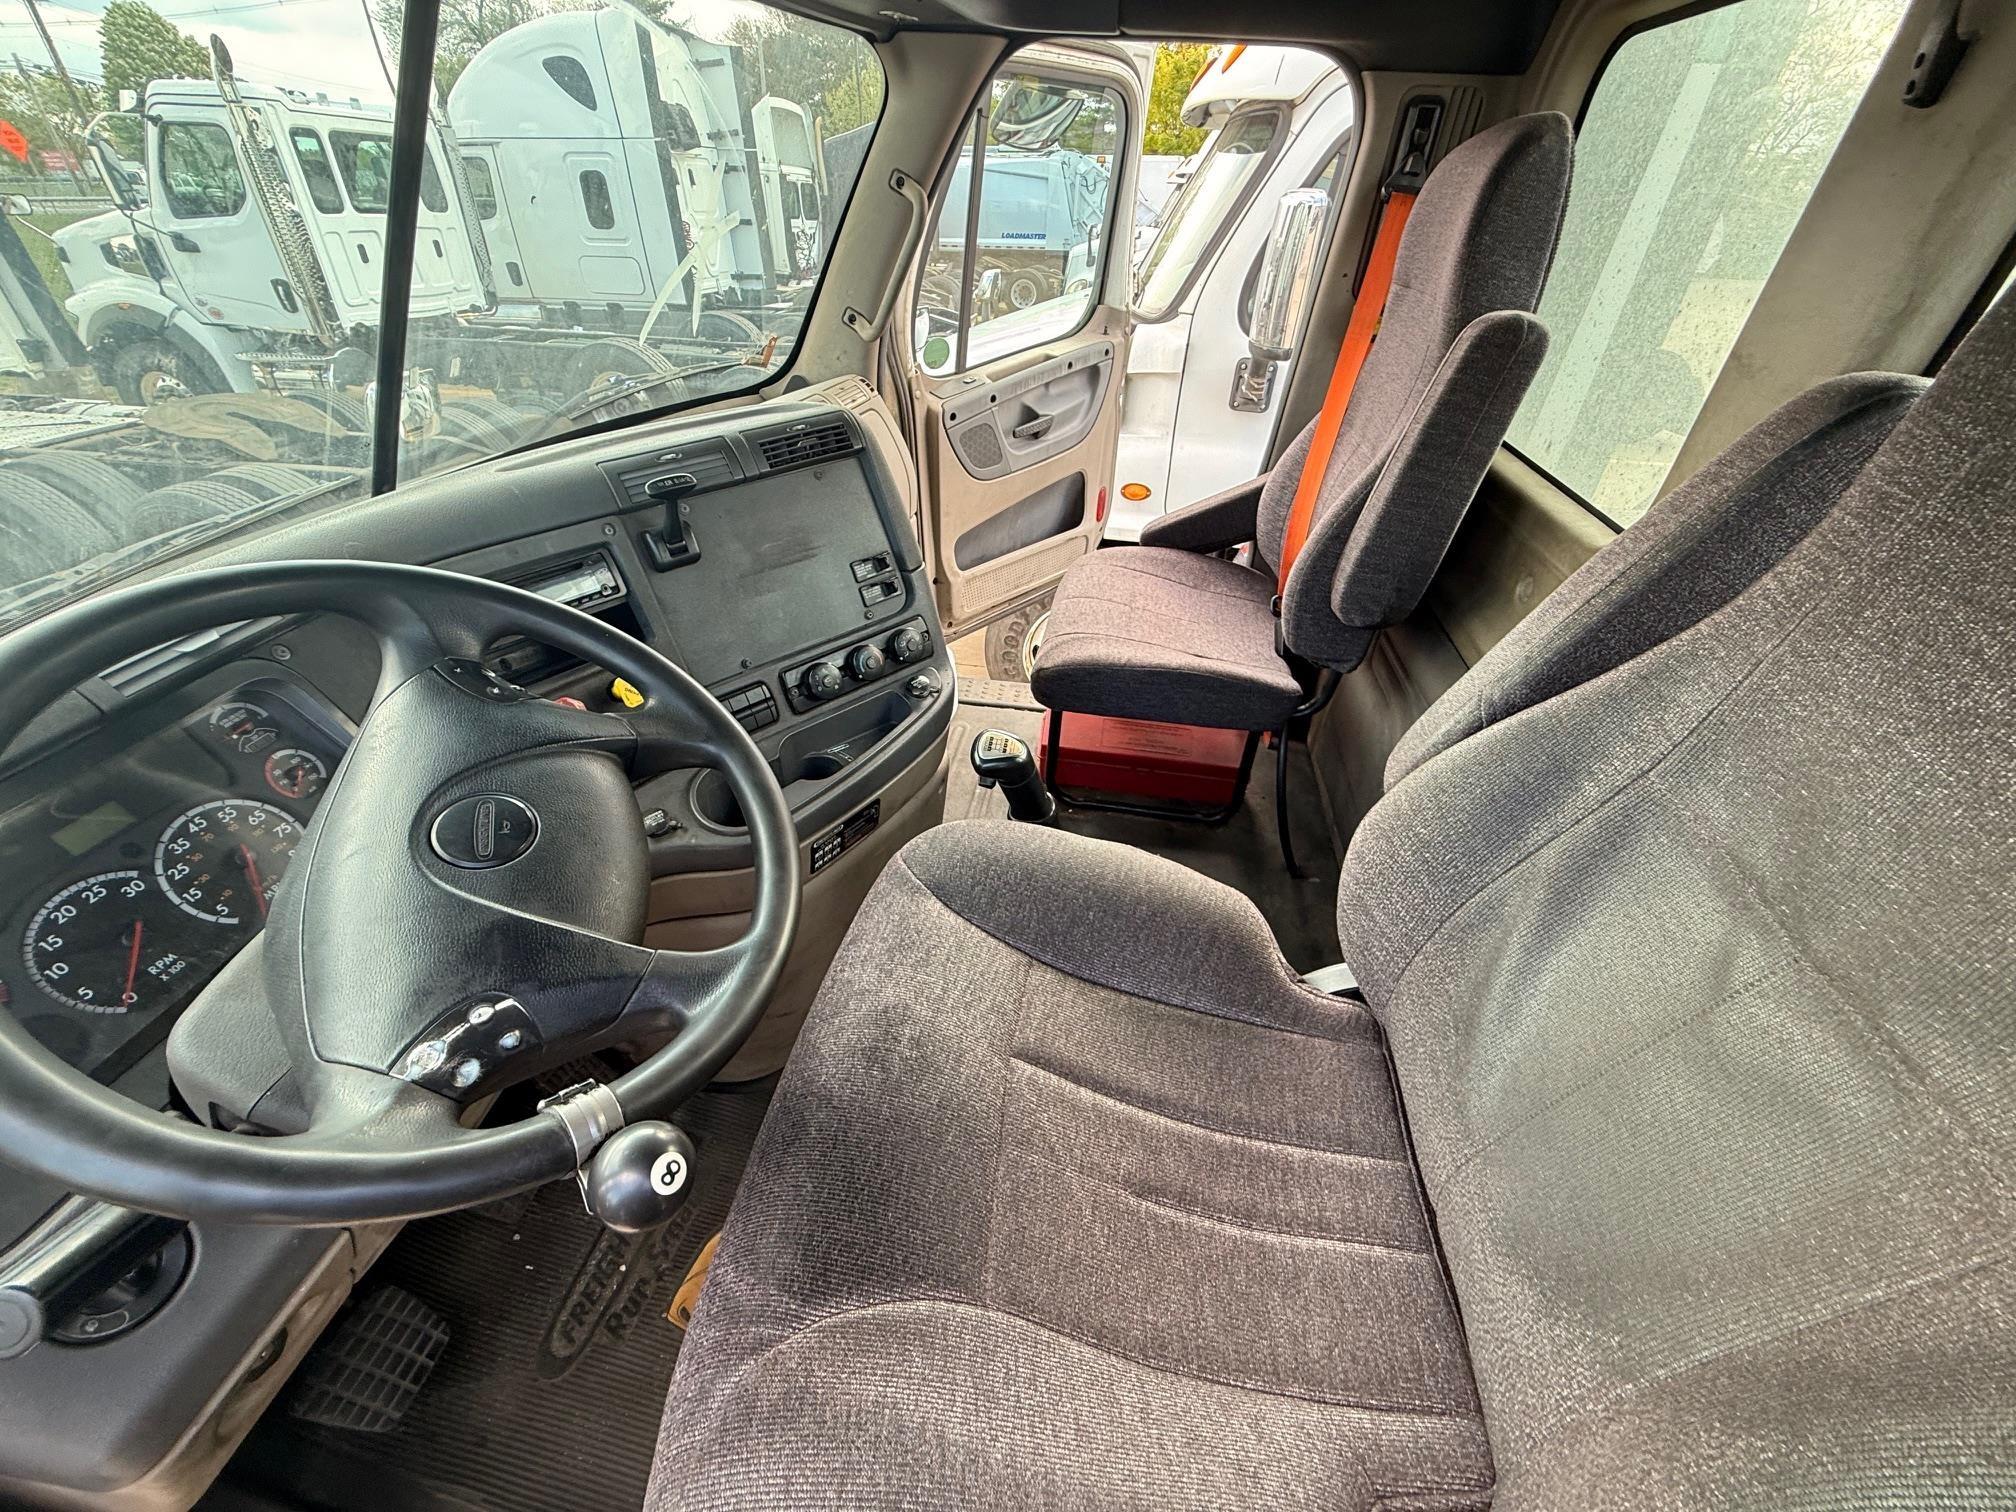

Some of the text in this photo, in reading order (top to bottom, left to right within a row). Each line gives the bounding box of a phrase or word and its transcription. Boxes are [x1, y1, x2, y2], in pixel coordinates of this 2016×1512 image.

[1001, 232, 1047, 240] LOADMASTER
[217, 806, 237, 823] 55
[248, 809, 266, 825] 65
[188, 815, 207, 833] 45
[272, 822, 291, 838] 75
[168, 837, 191, 854] 35
[167, 862, 190, 881] 25
[81, 884, 107, 904] 25
[120, 880, 146, 898] 30
[182, 887, 202, 903] 15
[263, 882, 280, 900] MP
[50, 905, 77, 925] 20
[216, 903, 229, 915] 5
[38, 934, 64, 952] 15
[43, 962, 69, 980] 10
[147, 953, 178, 975] RPM
[167, 960, 186, 975] 100
[77, 986, 94, 1000] 5
[122, 992, 138, 1003] 0
[660, 1159, 681, 1187] 8
